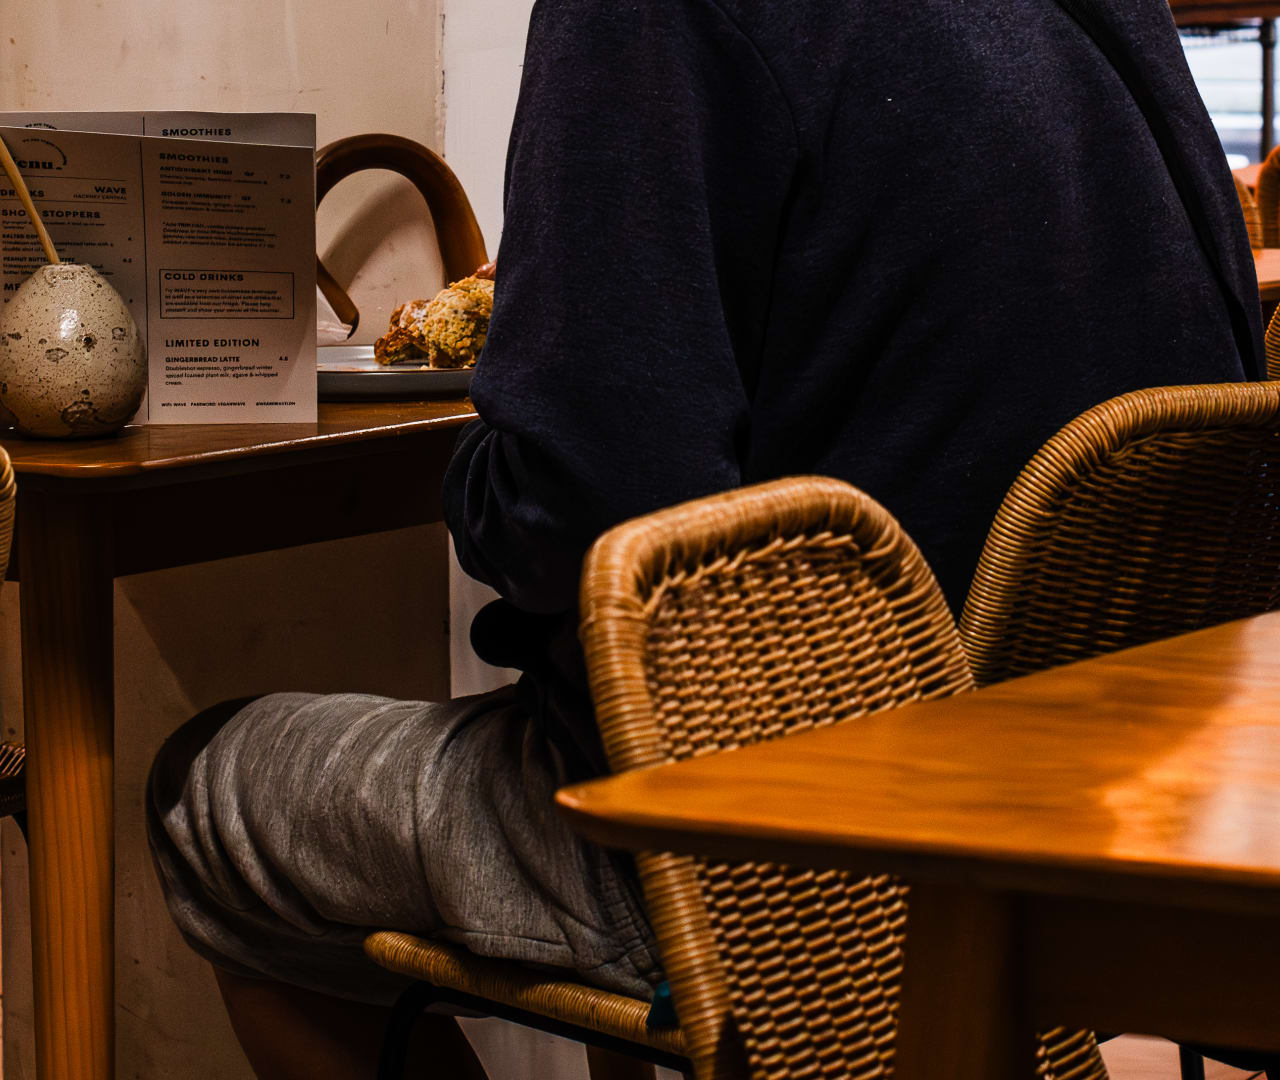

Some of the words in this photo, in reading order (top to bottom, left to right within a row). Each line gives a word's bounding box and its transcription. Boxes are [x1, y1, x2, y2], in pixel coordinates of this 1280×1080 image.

[162, 128, 232, 136] SMOOTHIES
[159, 153, 229, 164] SMOOTHIES
[0, 188, 45, 198] DRKS
[94, 185, 127, 195] WAVE
[1, 209, 26, 217] SHO
[42, 209, 101, 219] STOPPERS
[164, 272, 196, 281] COLD
[199, 273, 244, 282] DRINKS
[165, 338, 210, 348] LIMITED
[213, 338, 260, 347] EDITION
